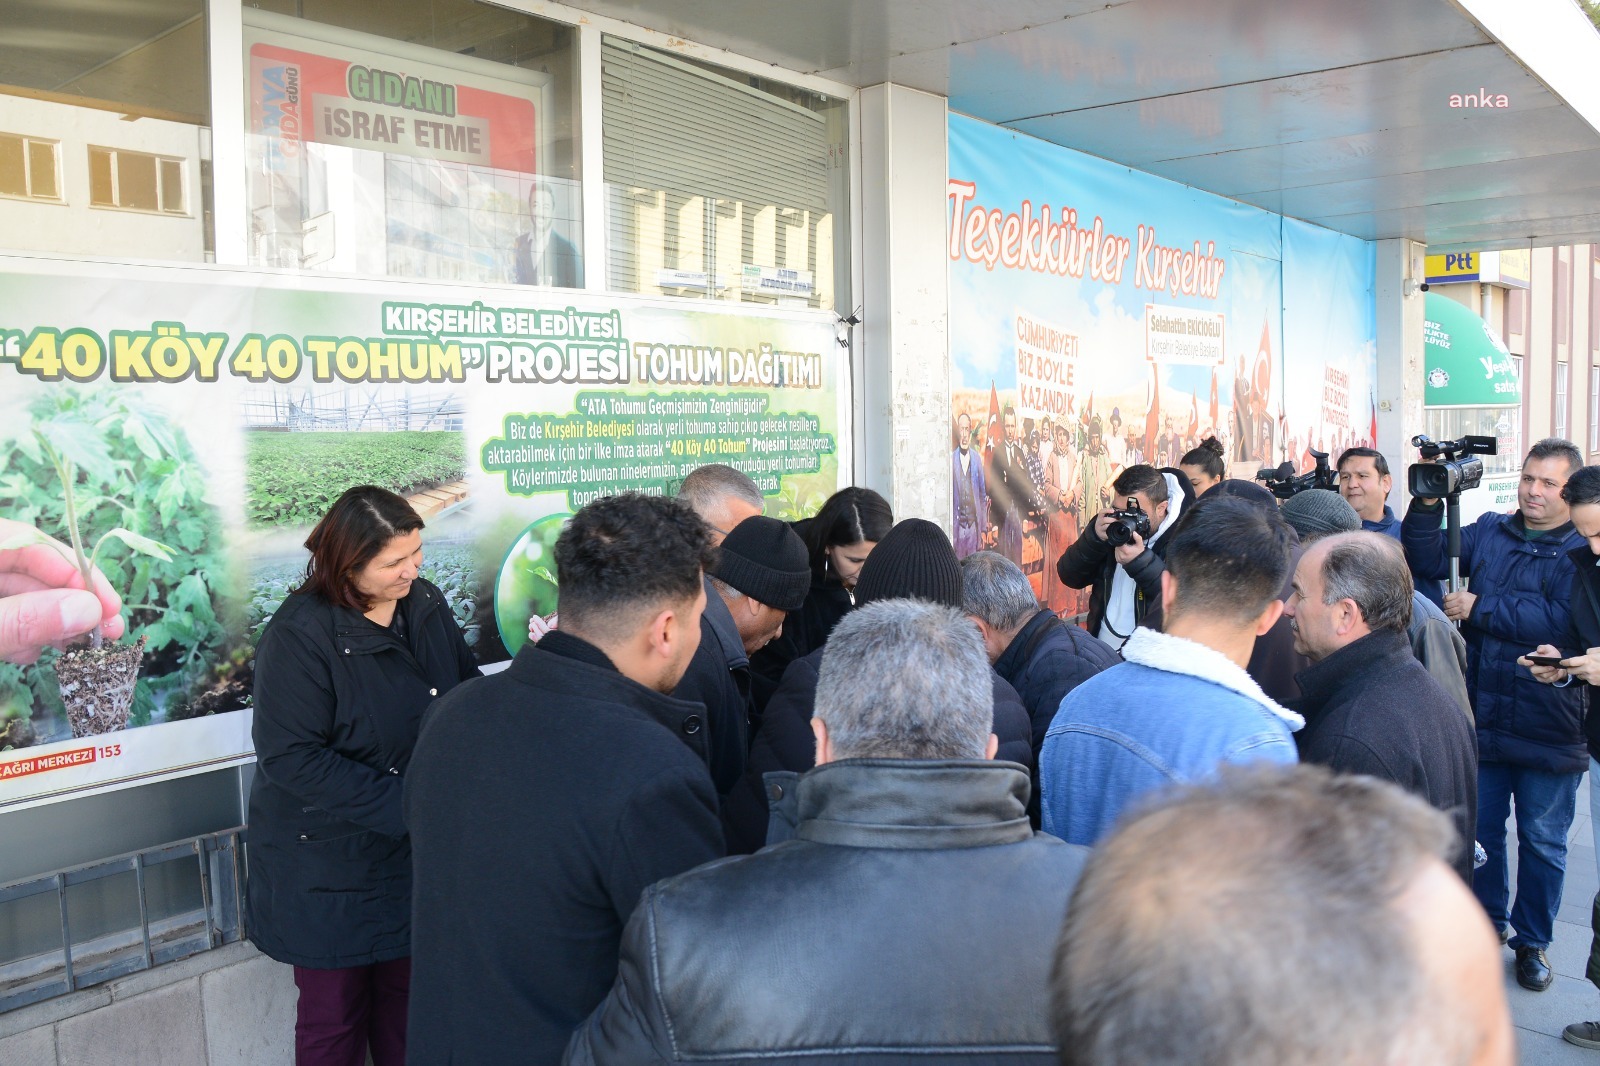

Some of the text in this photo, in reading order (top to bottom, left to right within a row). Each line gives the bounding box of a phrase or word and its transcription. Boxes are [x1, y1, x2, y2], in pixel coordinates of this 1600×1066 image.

[285, 66, 299, 105] GÜNÜ
[350, 65, 456, 117] GIDANI
[324, 107, 482, 155] İSRAF ETME
[948, 178, 1225, 299] Teşekkürler Kırşehir
[1445, 253, 1473, 272] Ptt
[386, 306, 619, 339] KIRŞEHİR BELEDİYESİ
[1017, 315, 1079, 358] CÜMHURİYETİ
[1150, 314, 1187, 335] Selahattin
[114, 326, 225, 378] KÖY
[233, 338, 299, 379] 40
[489, 341, 628, 380] PROJESİ
[636, 346, 722, 382] TOHUM
[728, 345, 820, 386] DAĞITIMI
[1018, 347, 1074, 387] BİZ BÖYLE
[581, 397, 767, 416] “ATA Tohumu Geçmişimizin Zenginliğidir”
[1020, 382, 1075, 416] KAZANDIK
[510, 422, 526, 440] Biz
[529, 422, 542, 439] de
[544, 420, 584, 441] Kırşehir
[586, 419, 635, 440] Belediyesi
[636, 418, 662, 436] olarak
[665, 418, 684, 438] yerli
[686, 419, 716, 435] tohuma
[718, 418, 739, 436] sahip
[740, 417, 757, 436] çıkıp
[760, 417, 787, 436] gelecek
[488, 436, 832, 465] aktarabilmek için bir ilke imza atarak “40 Köy 40 Tohum” Projesini başlatıyoruz.
[511, 469, 578, 489] Köylerimizde
[580, 464, 618, 483] bulunan
[620, 461, 679, 480] ninelerimizin,
[730, 456, 766, 474] koruduğu
[767, 455, 783, 473] yerli
[785, 454, 818, 470] tohumları
[37, 749, 93, 770] MERKEZİ
[98, 744, 122, 759] 153
